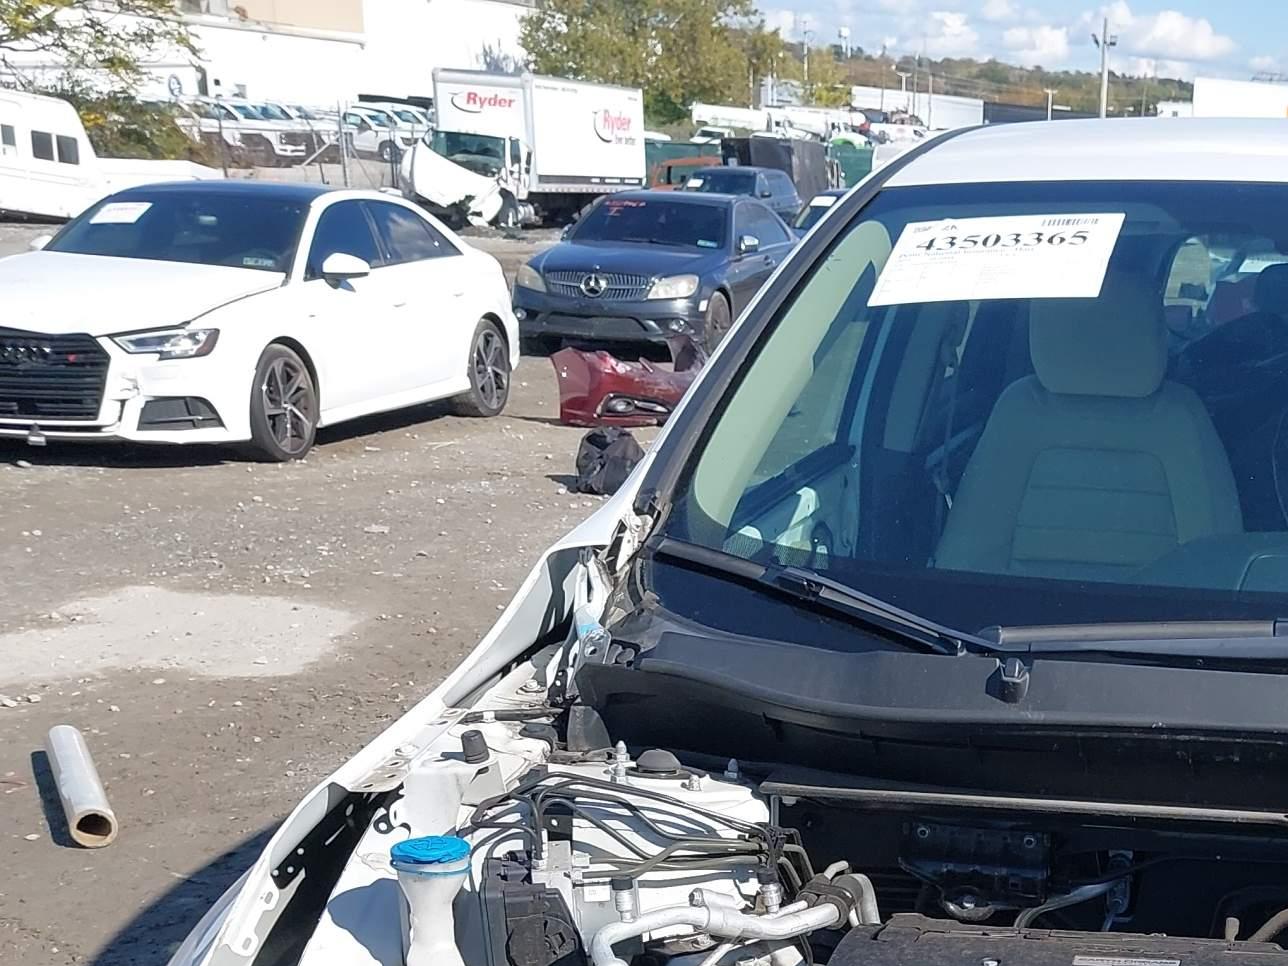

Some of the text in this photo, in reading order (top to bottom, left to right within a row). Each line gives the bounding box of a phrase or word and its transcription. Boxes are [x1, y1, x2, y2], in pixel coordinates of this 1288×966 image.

[466, 91, 516, 109] Ryder
[603, 109, 631, 135] Ryder
[916, 230, 1091, 250] 43503365
